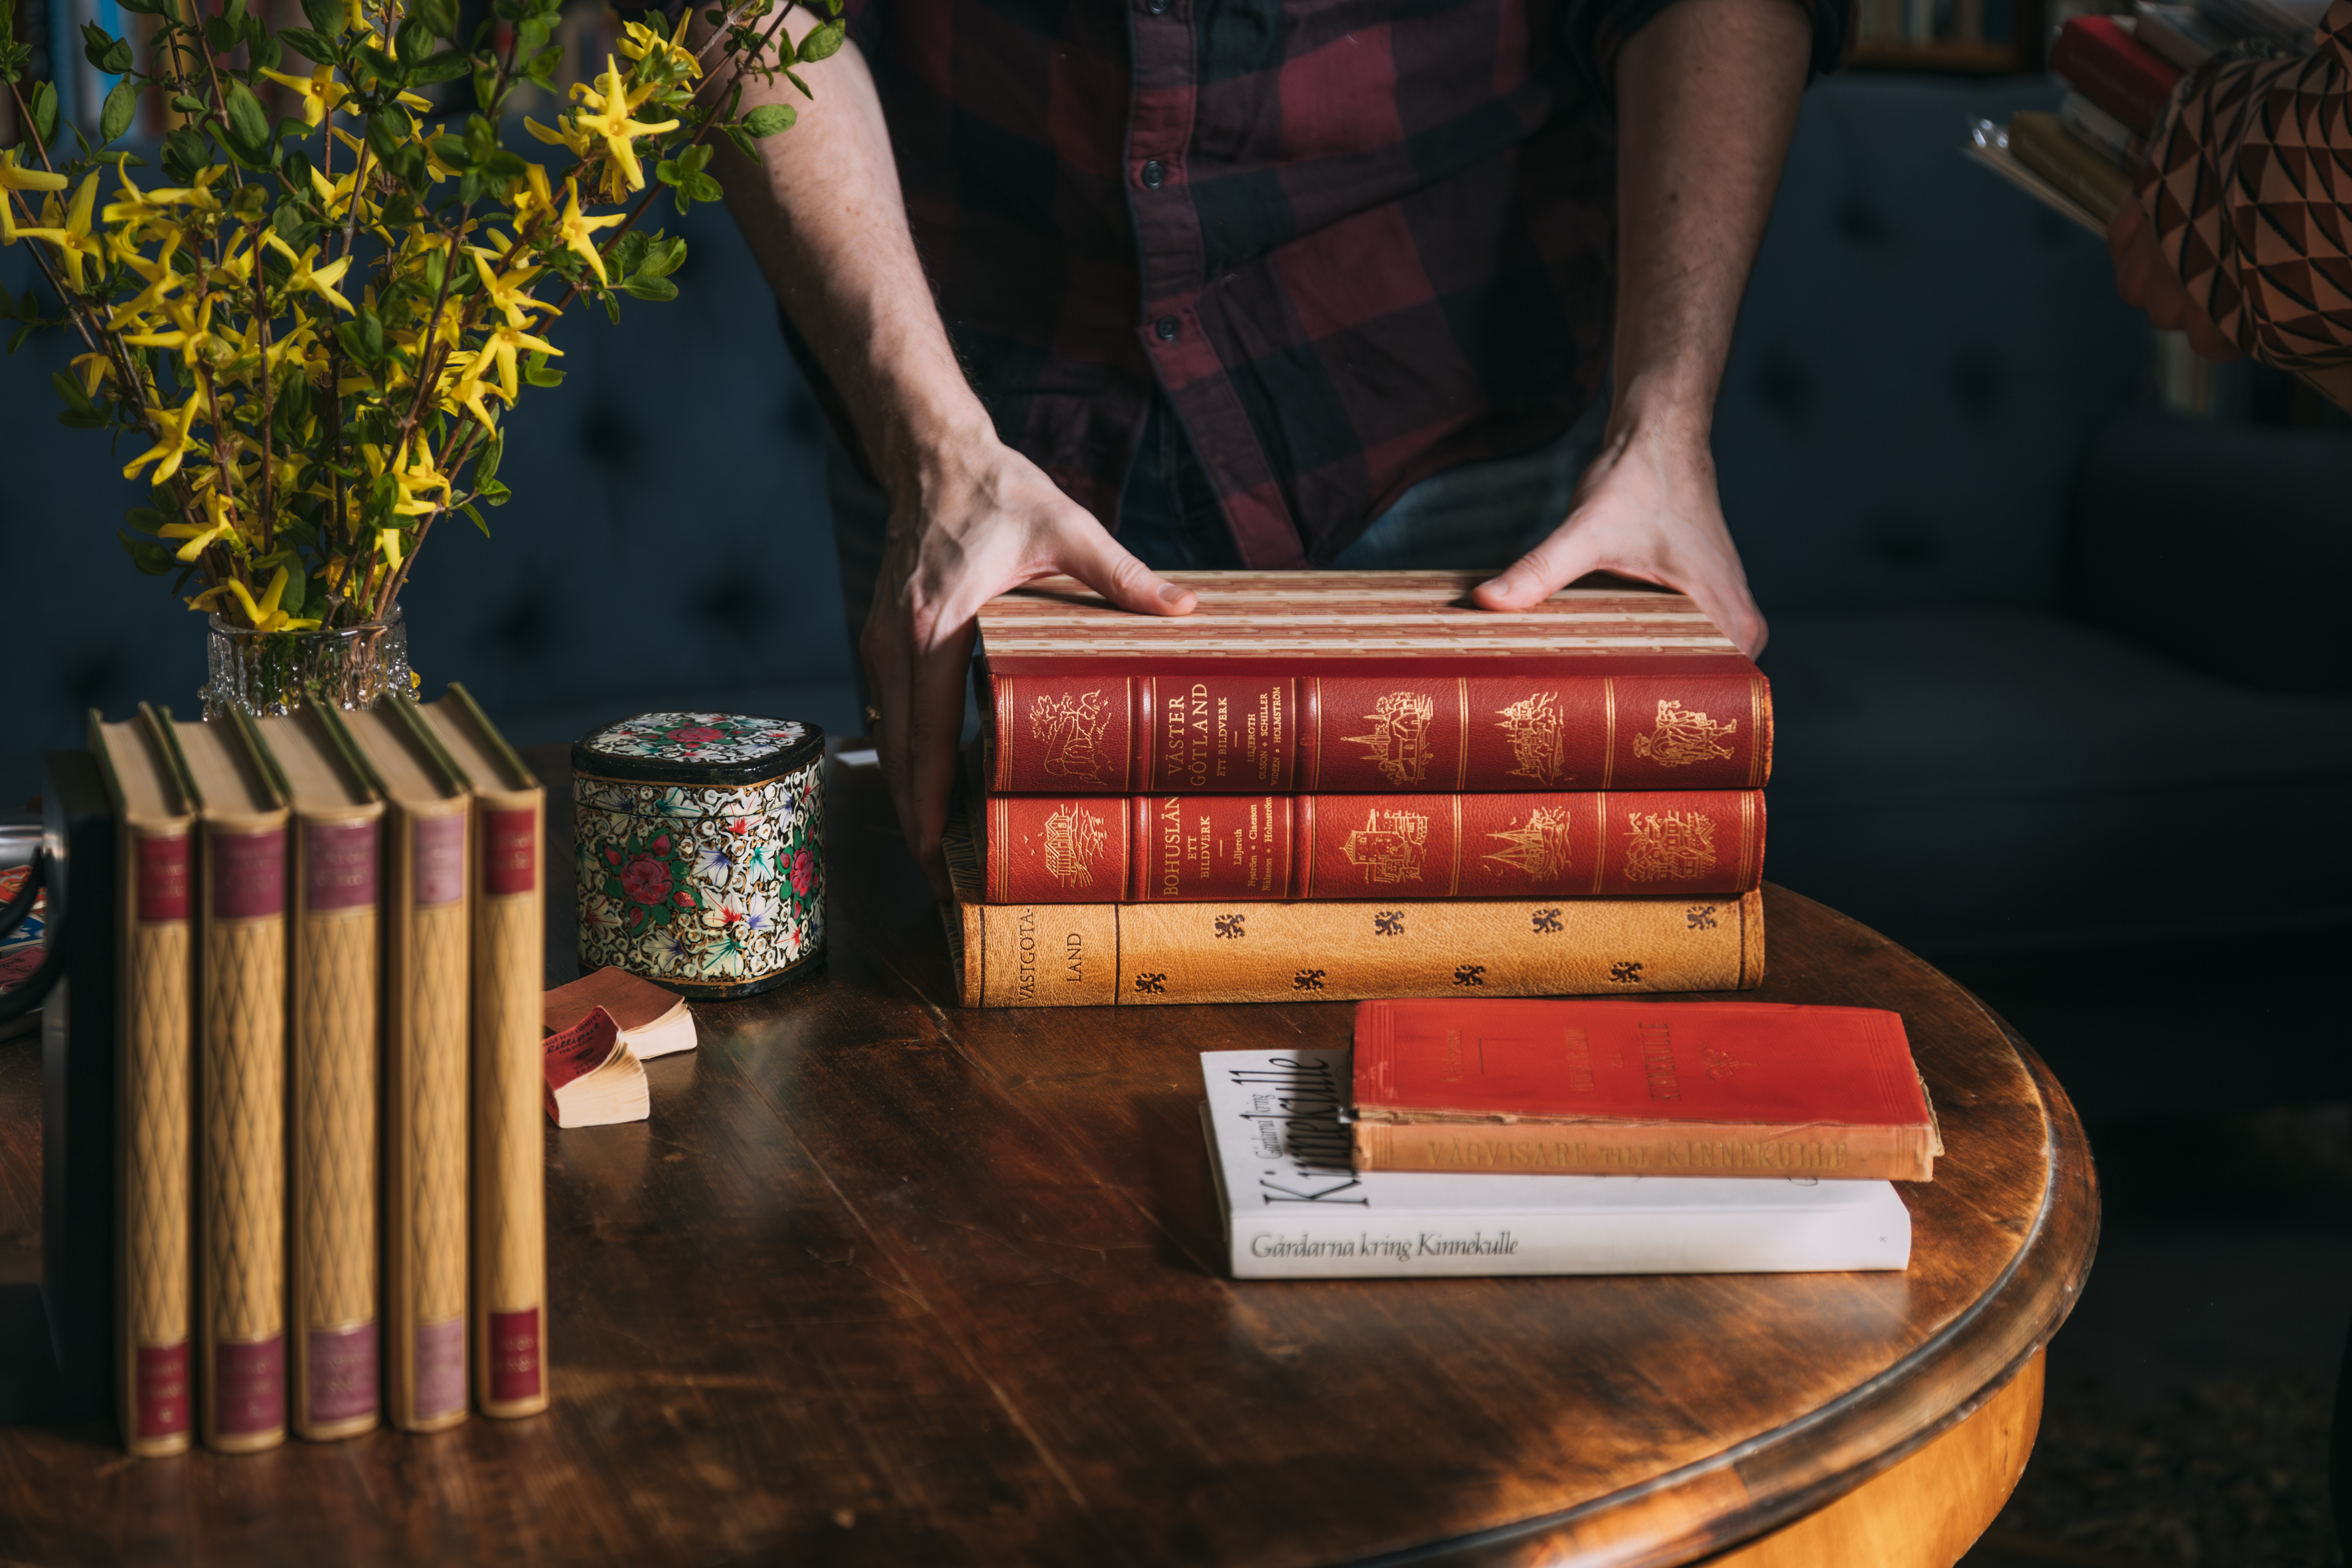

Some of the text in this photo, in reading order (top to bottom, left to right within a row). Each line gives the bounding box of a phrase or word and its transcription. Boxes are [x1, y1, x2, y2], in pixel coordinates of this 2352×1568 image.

[1166, 696, 1185, 775] VÄSTER
[1188, 684, 1208, 786] GÖTLAND
[1217, 697, 1227, 777] ETT BILDVERK
[1247, 714, 1257, 763] LILJEROTH
[1259, 693, 1269, 779] OLSSON SCHILLER
[1273, 686, 1282, 744] HOLMSTRÖM
[1161, 797, 1181, 896] BOHUSLÄN
[1188, 836, 1197, 860] ETT
[1200, 816, 1210, 878] BILDVERK
[1234, 828, 1244, 865] Liljeroth
[1248, 804, 1259, 887] Nyström Claesson
[1263, 858, 1273, 891] Niklasson
[1066, 933, 1082, 982] LAND
[1228, 1058, 1370, 1209] Kinnekulle
[1664, 1142, 1847, 1169] KINNEKULLE
[1251, 1230, 1520, 1262] Gårdarna kring Kinnekulle
